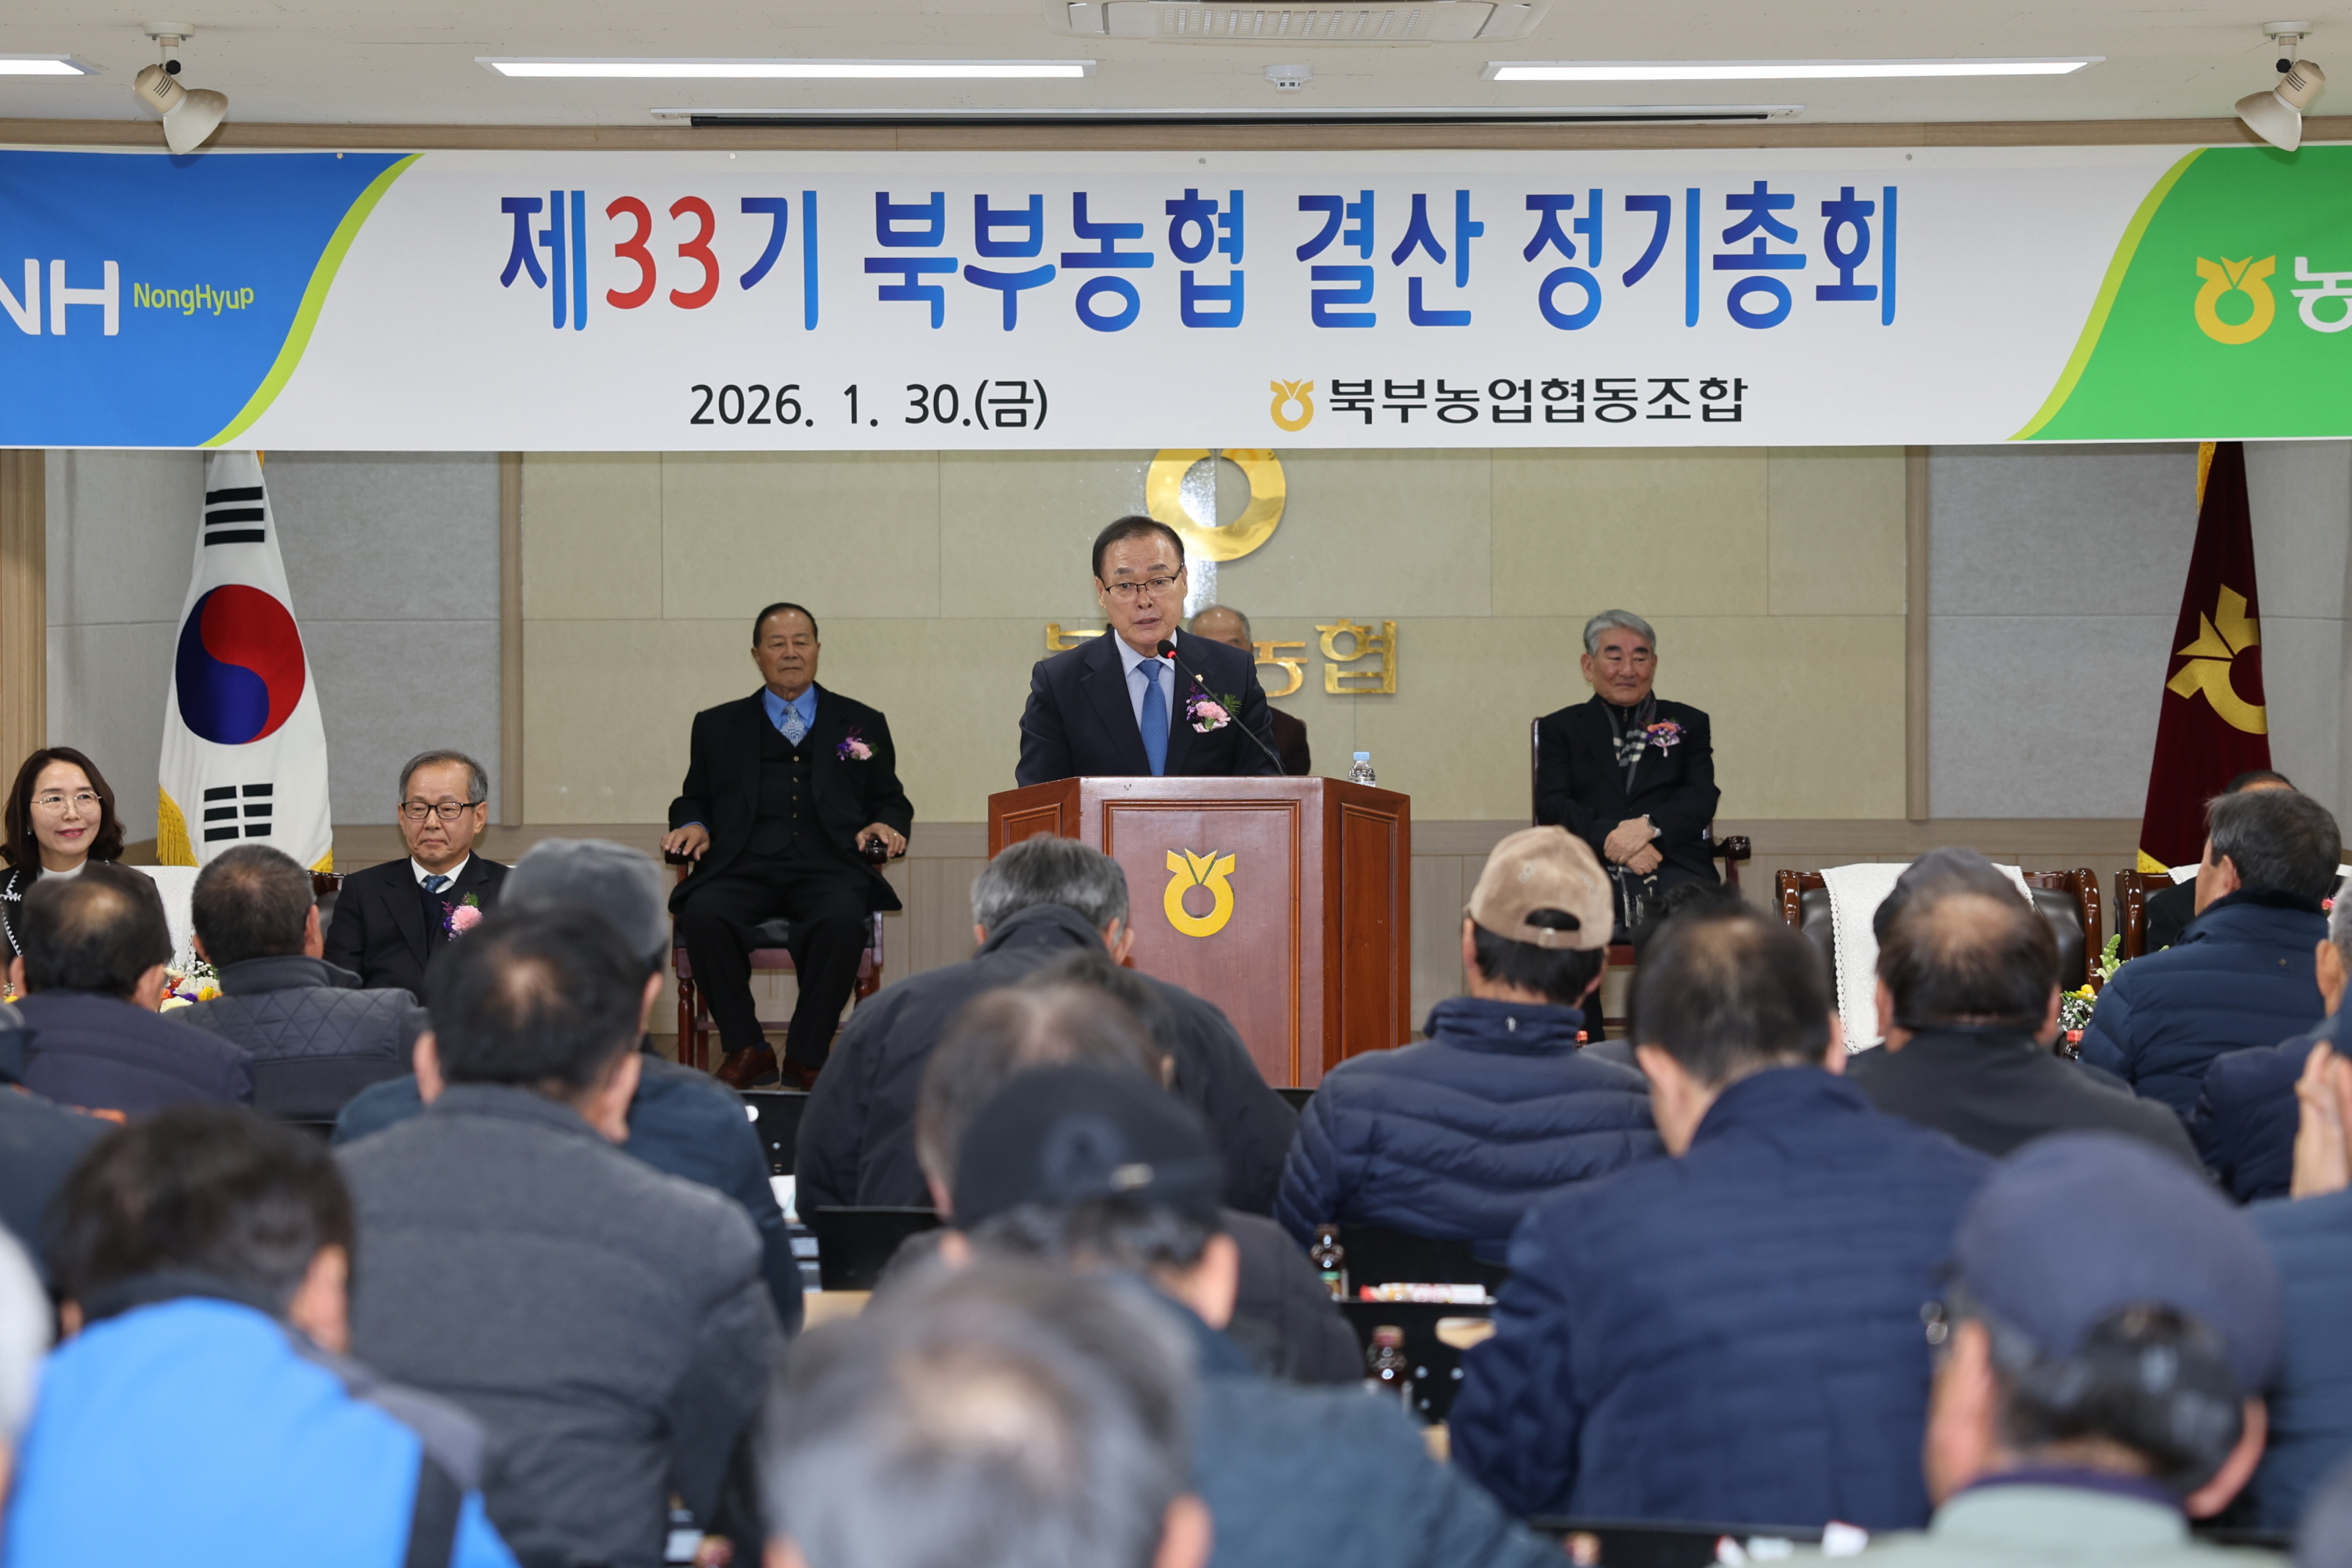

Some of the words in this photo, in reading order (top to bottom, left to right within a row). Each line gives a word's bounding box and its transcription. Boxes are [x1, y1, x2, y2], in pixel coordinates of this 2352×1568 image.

[501, 191, 818, 332] 제33기
[865, 189, 1244, 332] 북부농협
[1297, 190, 1484, 328] 결산
[1524, 181, 1897, 331] 정기총회
[134, 282, 254, 315] NongHyup
[690, 383, 814, 427] 2026.
[844, 384, 878, 427] 1.
[905, 379, 1047, 430] 30.(금)
[1329, 377, 1748, 425] 북부농업협동조합
